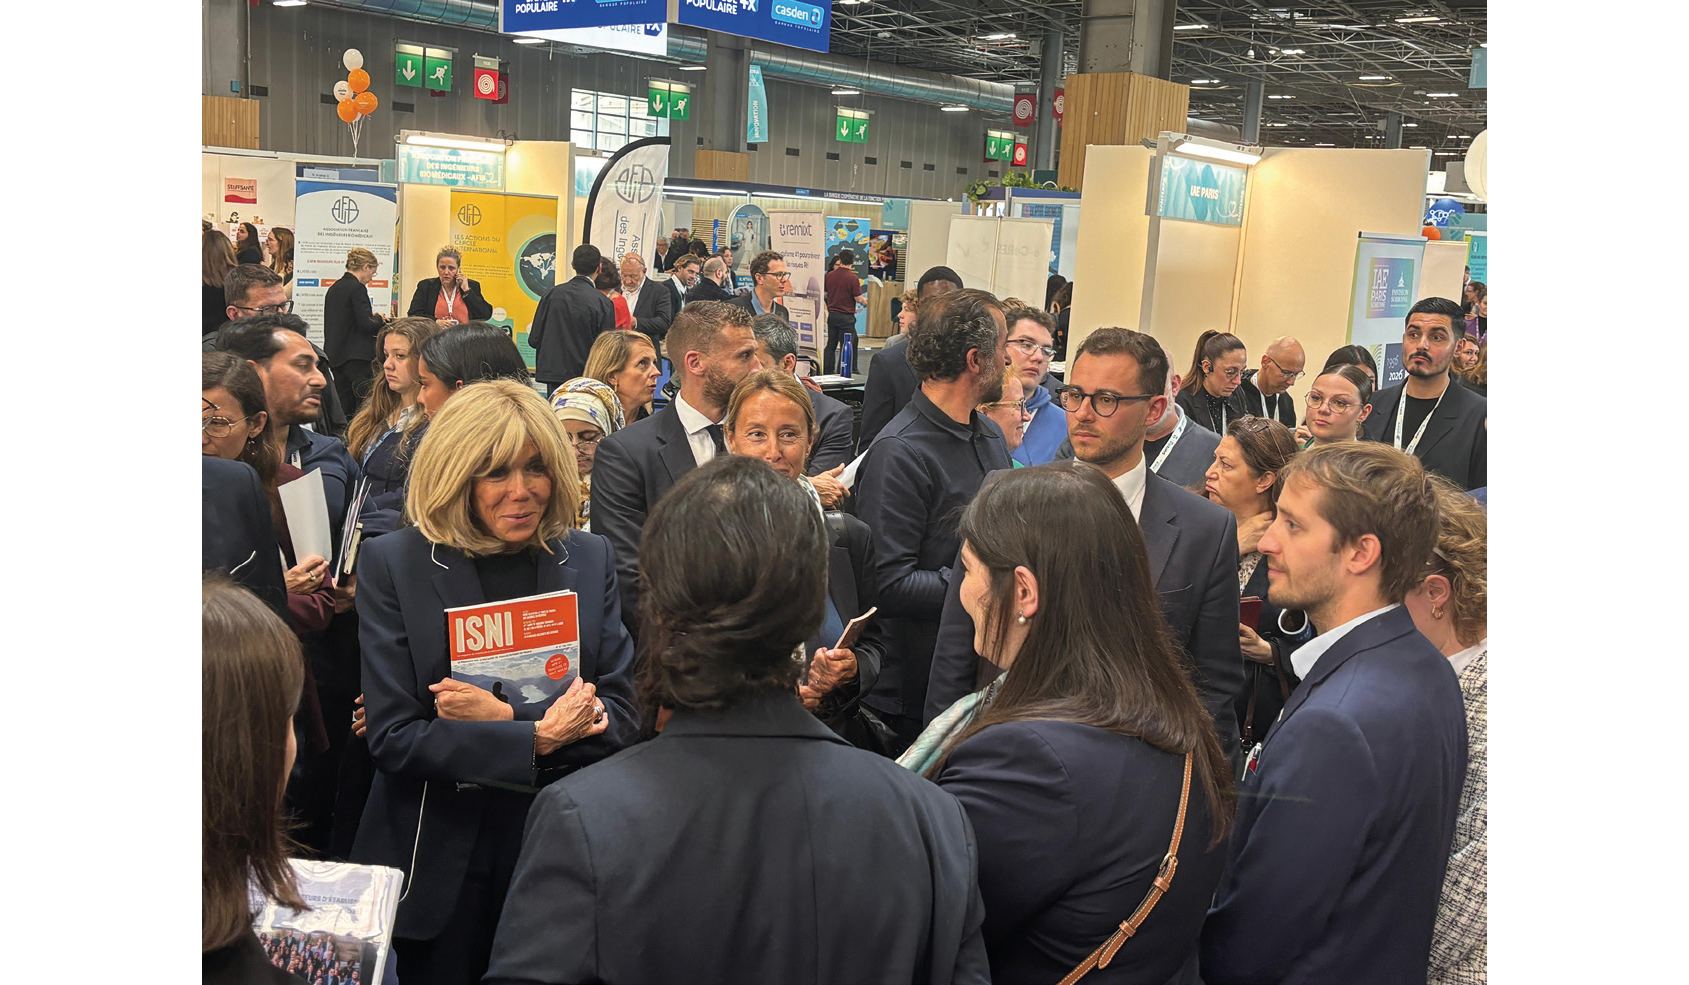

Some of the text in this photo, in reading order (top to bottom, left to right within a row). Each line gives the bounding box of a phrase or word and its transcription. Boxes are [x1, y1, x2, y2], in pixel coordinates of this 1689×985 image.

[516, 1, 558, 13] POPULAIRE
[776, 4, 808, 20] casden
[440, 163, 480, 173] INGÉNIEURS
[420, 170, 466, 180] BIOMÉDICAUX
[1190, 184, 1219, 200] IAE PARIS
[620, 216, 629, 234] des
[786, 221, 812, 236] remixt
[1372, 268, 1389, 289] IAE
[1371, 290, 1386, 301] PARIS
[1389, 369, 1403, 381] 2026
[455, 612, 514, 653] ISNI
[322, 895, 359, 904] D'ÉTABLISS
